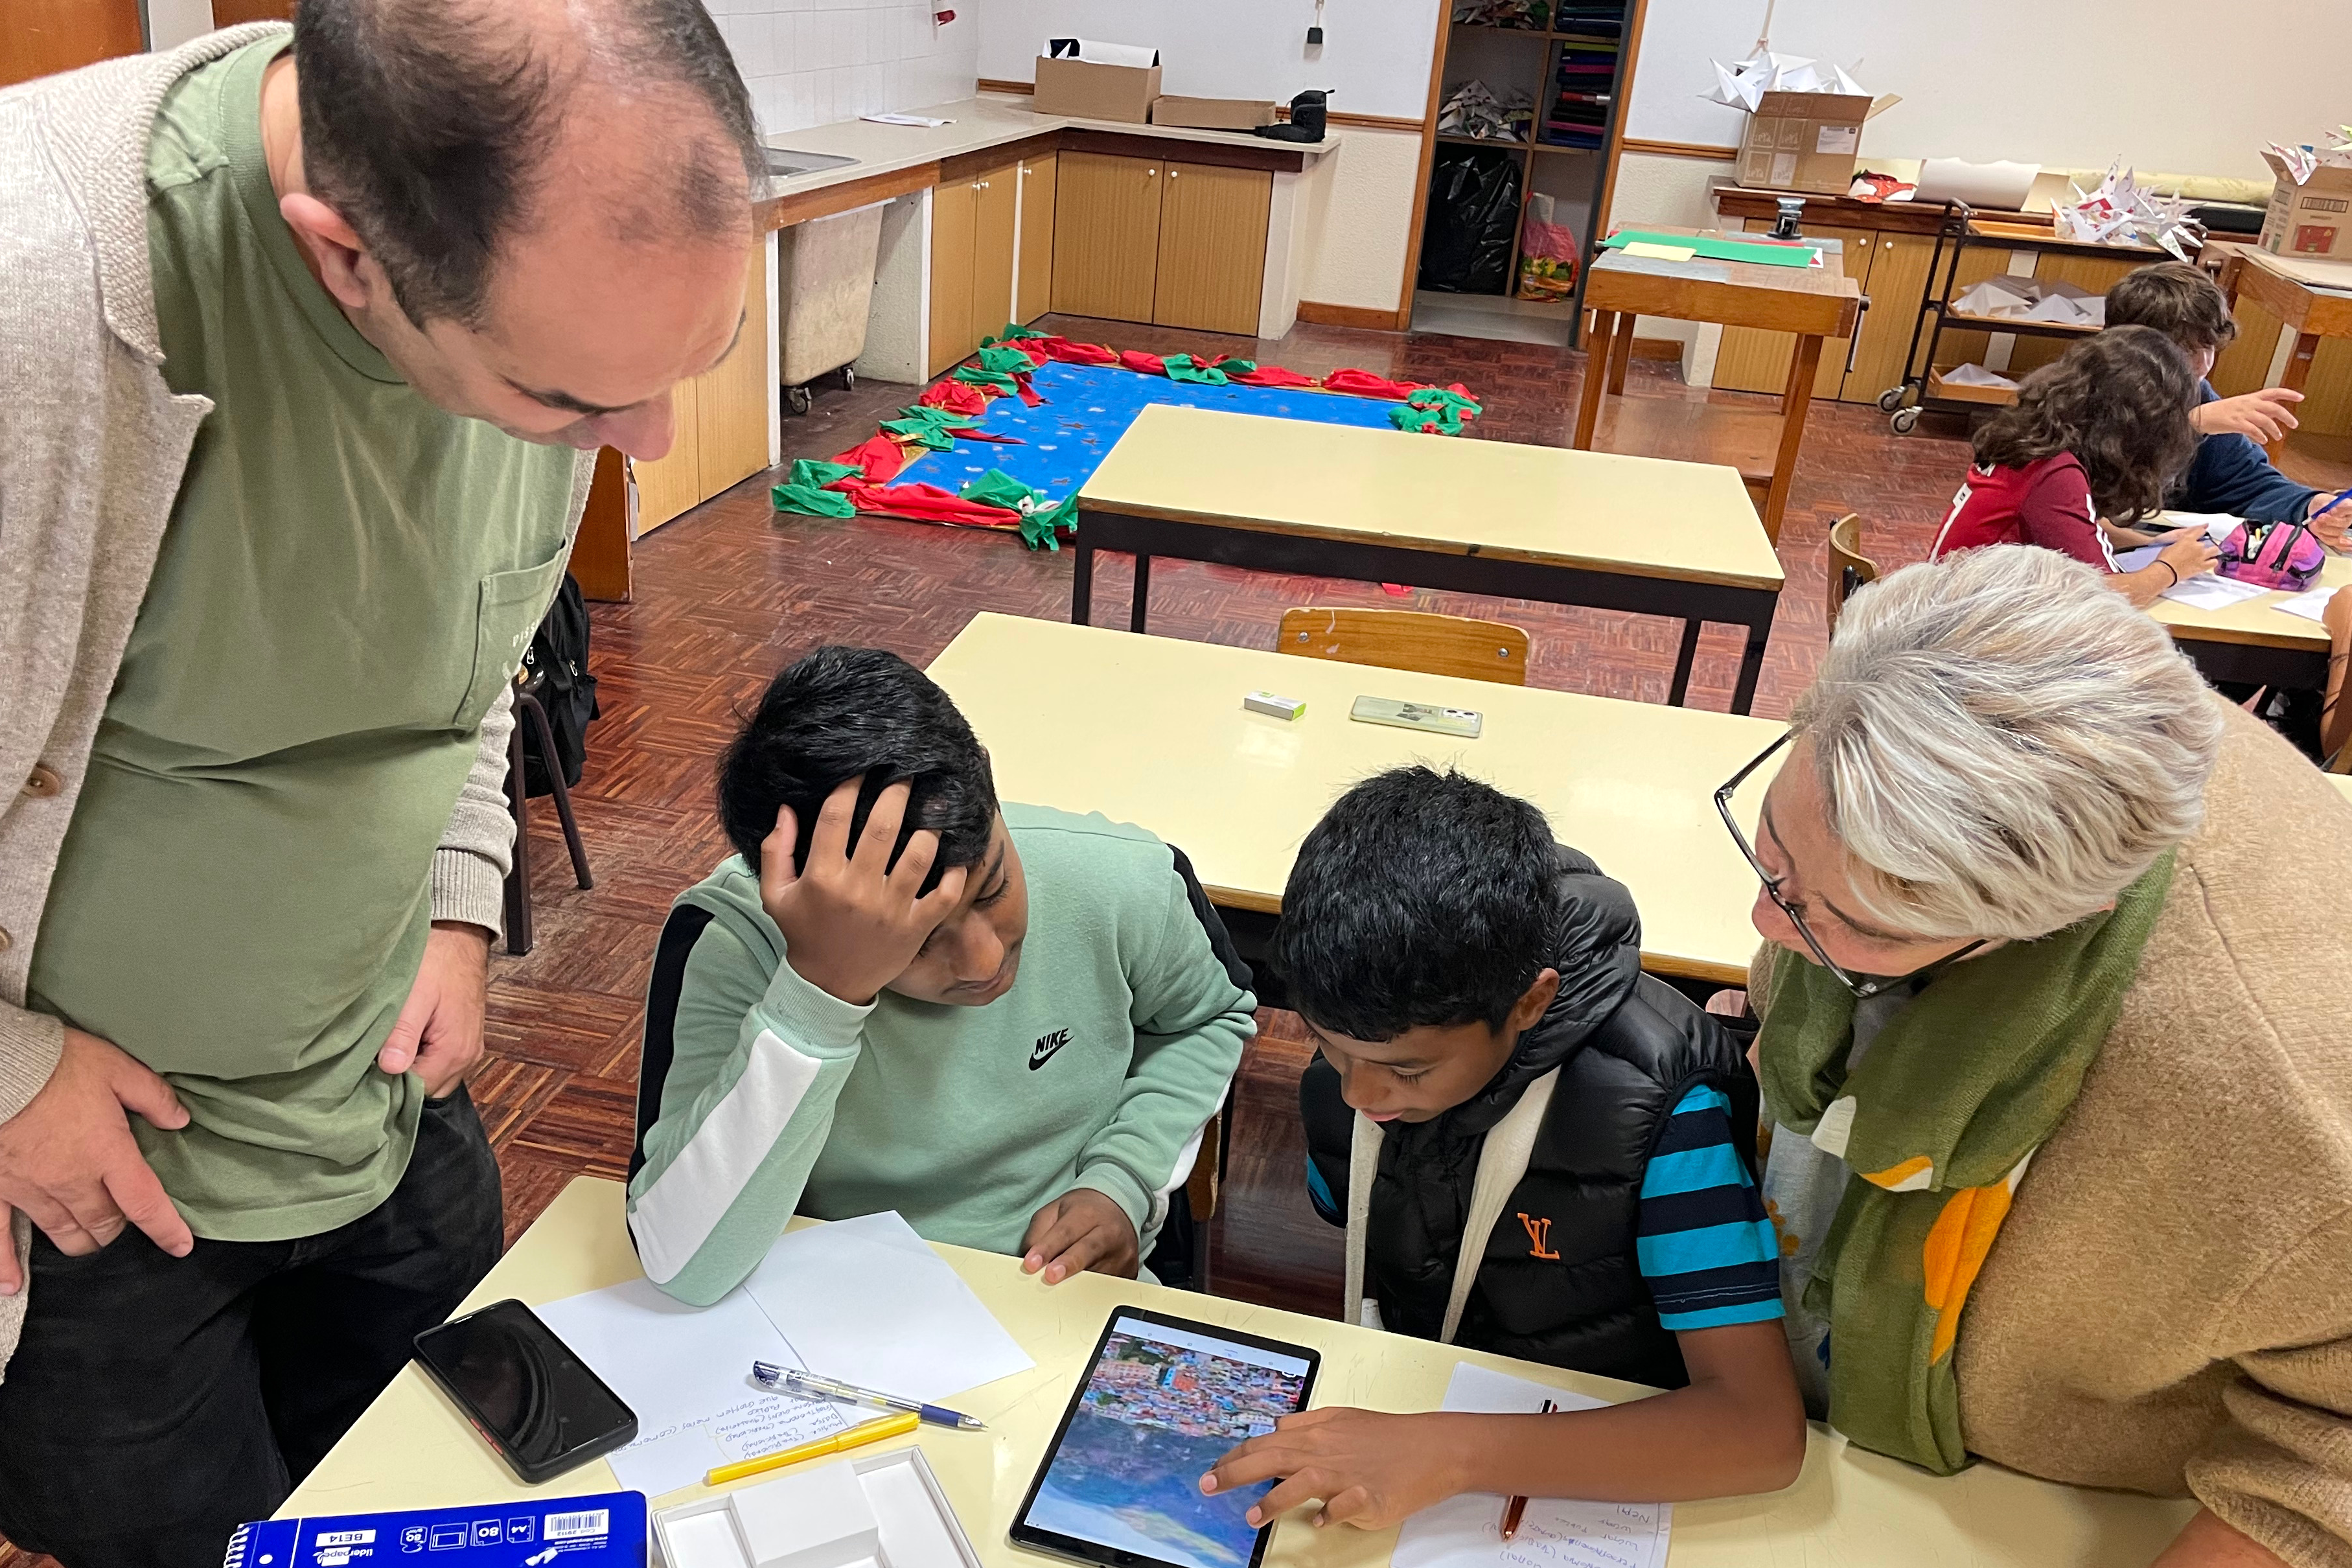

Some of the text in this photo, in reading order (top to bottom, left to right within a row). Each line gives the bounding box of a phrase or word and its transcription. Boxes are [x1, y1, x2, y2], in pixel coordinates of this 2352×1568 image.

[1035, 1028, 1069, 1055] NIKE
[478, 1527, 499, 1538] 80
[511, 1525, 527, 1534] A4
[329, 1533, 363, 1543] BE14
[406, 1534, 422, 1542] 80
